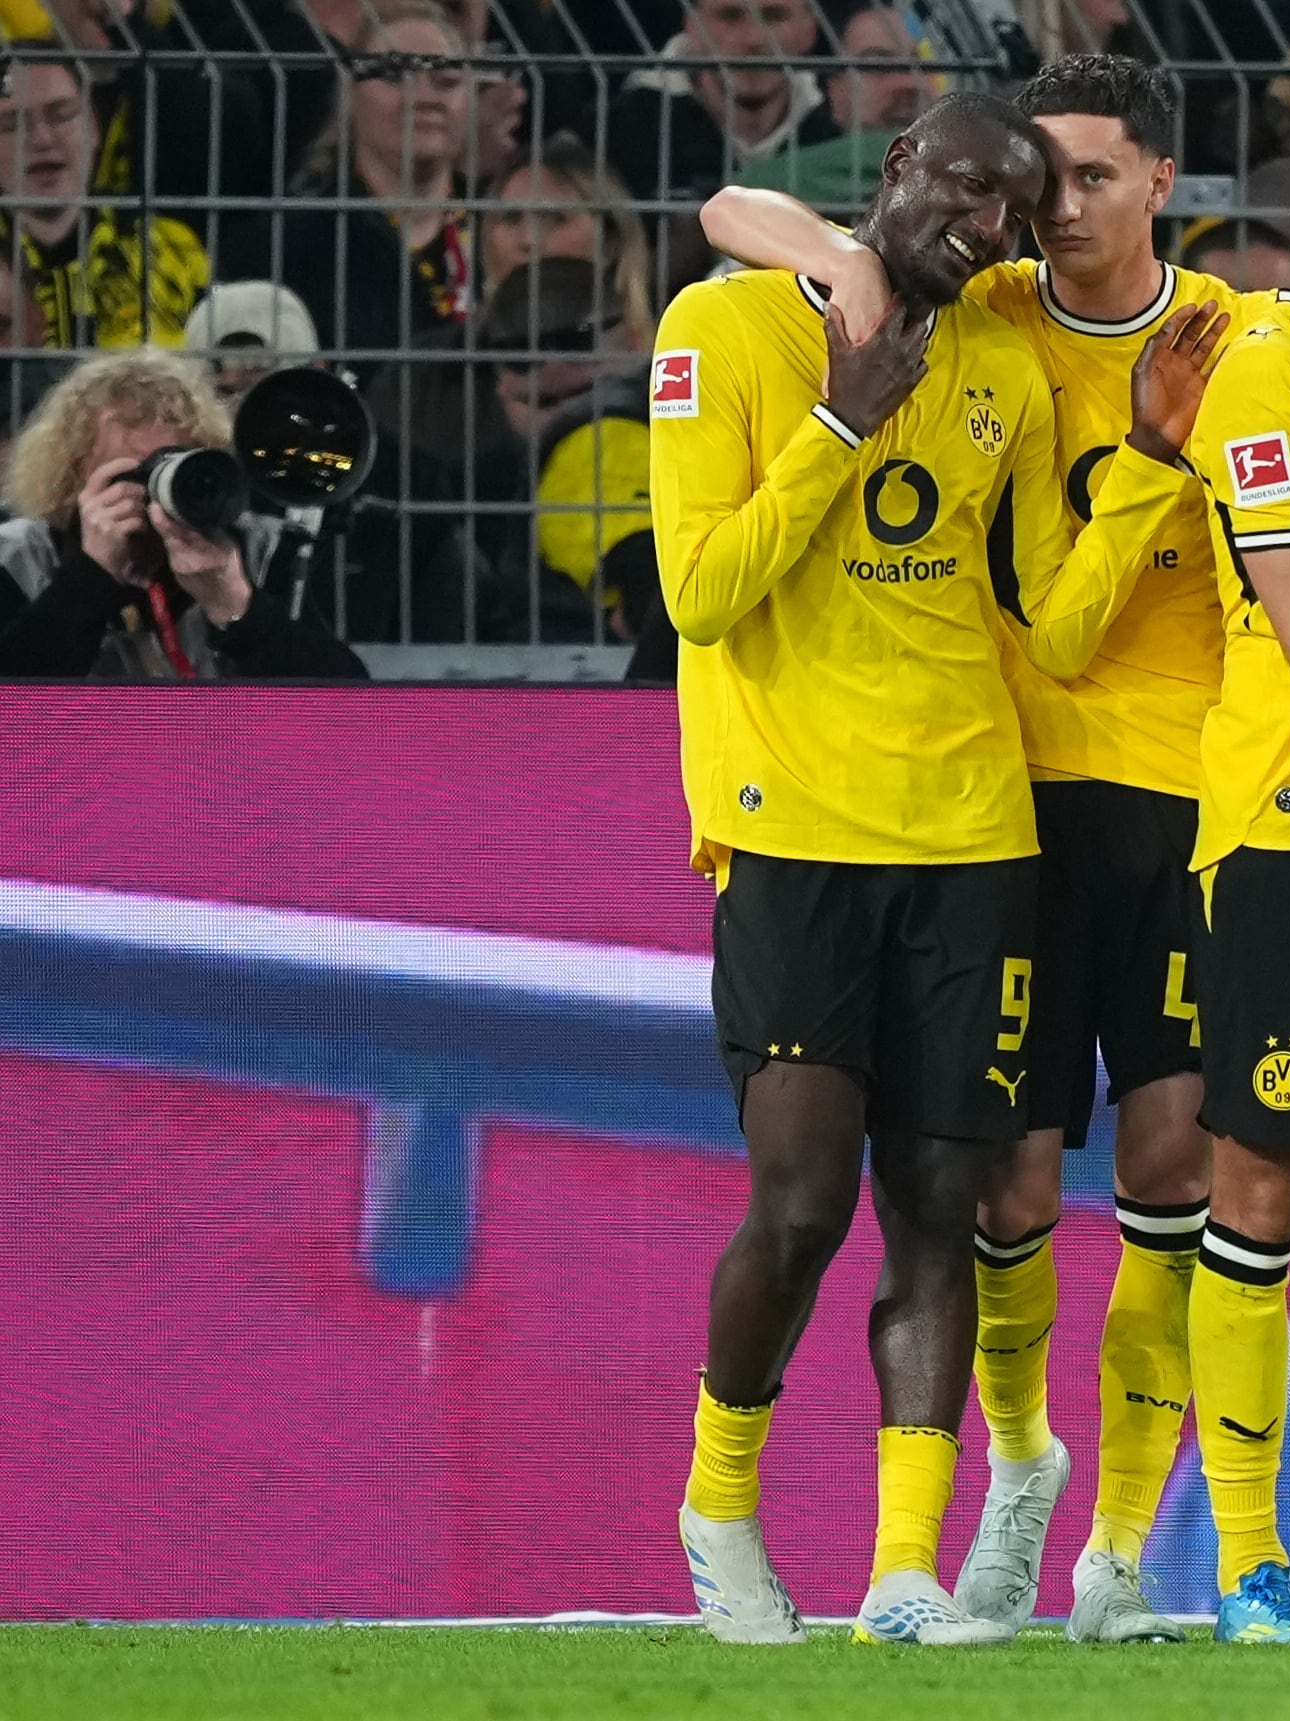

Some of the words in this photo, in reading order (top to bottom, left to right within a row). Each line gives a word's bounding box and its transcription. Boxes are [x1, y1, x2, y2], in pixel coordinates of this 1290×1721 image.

[970, 408, 1003, 442] BVB
[841, 555, 957, 583] vodafone
[1275, 1092, 1290, 1103] 09
